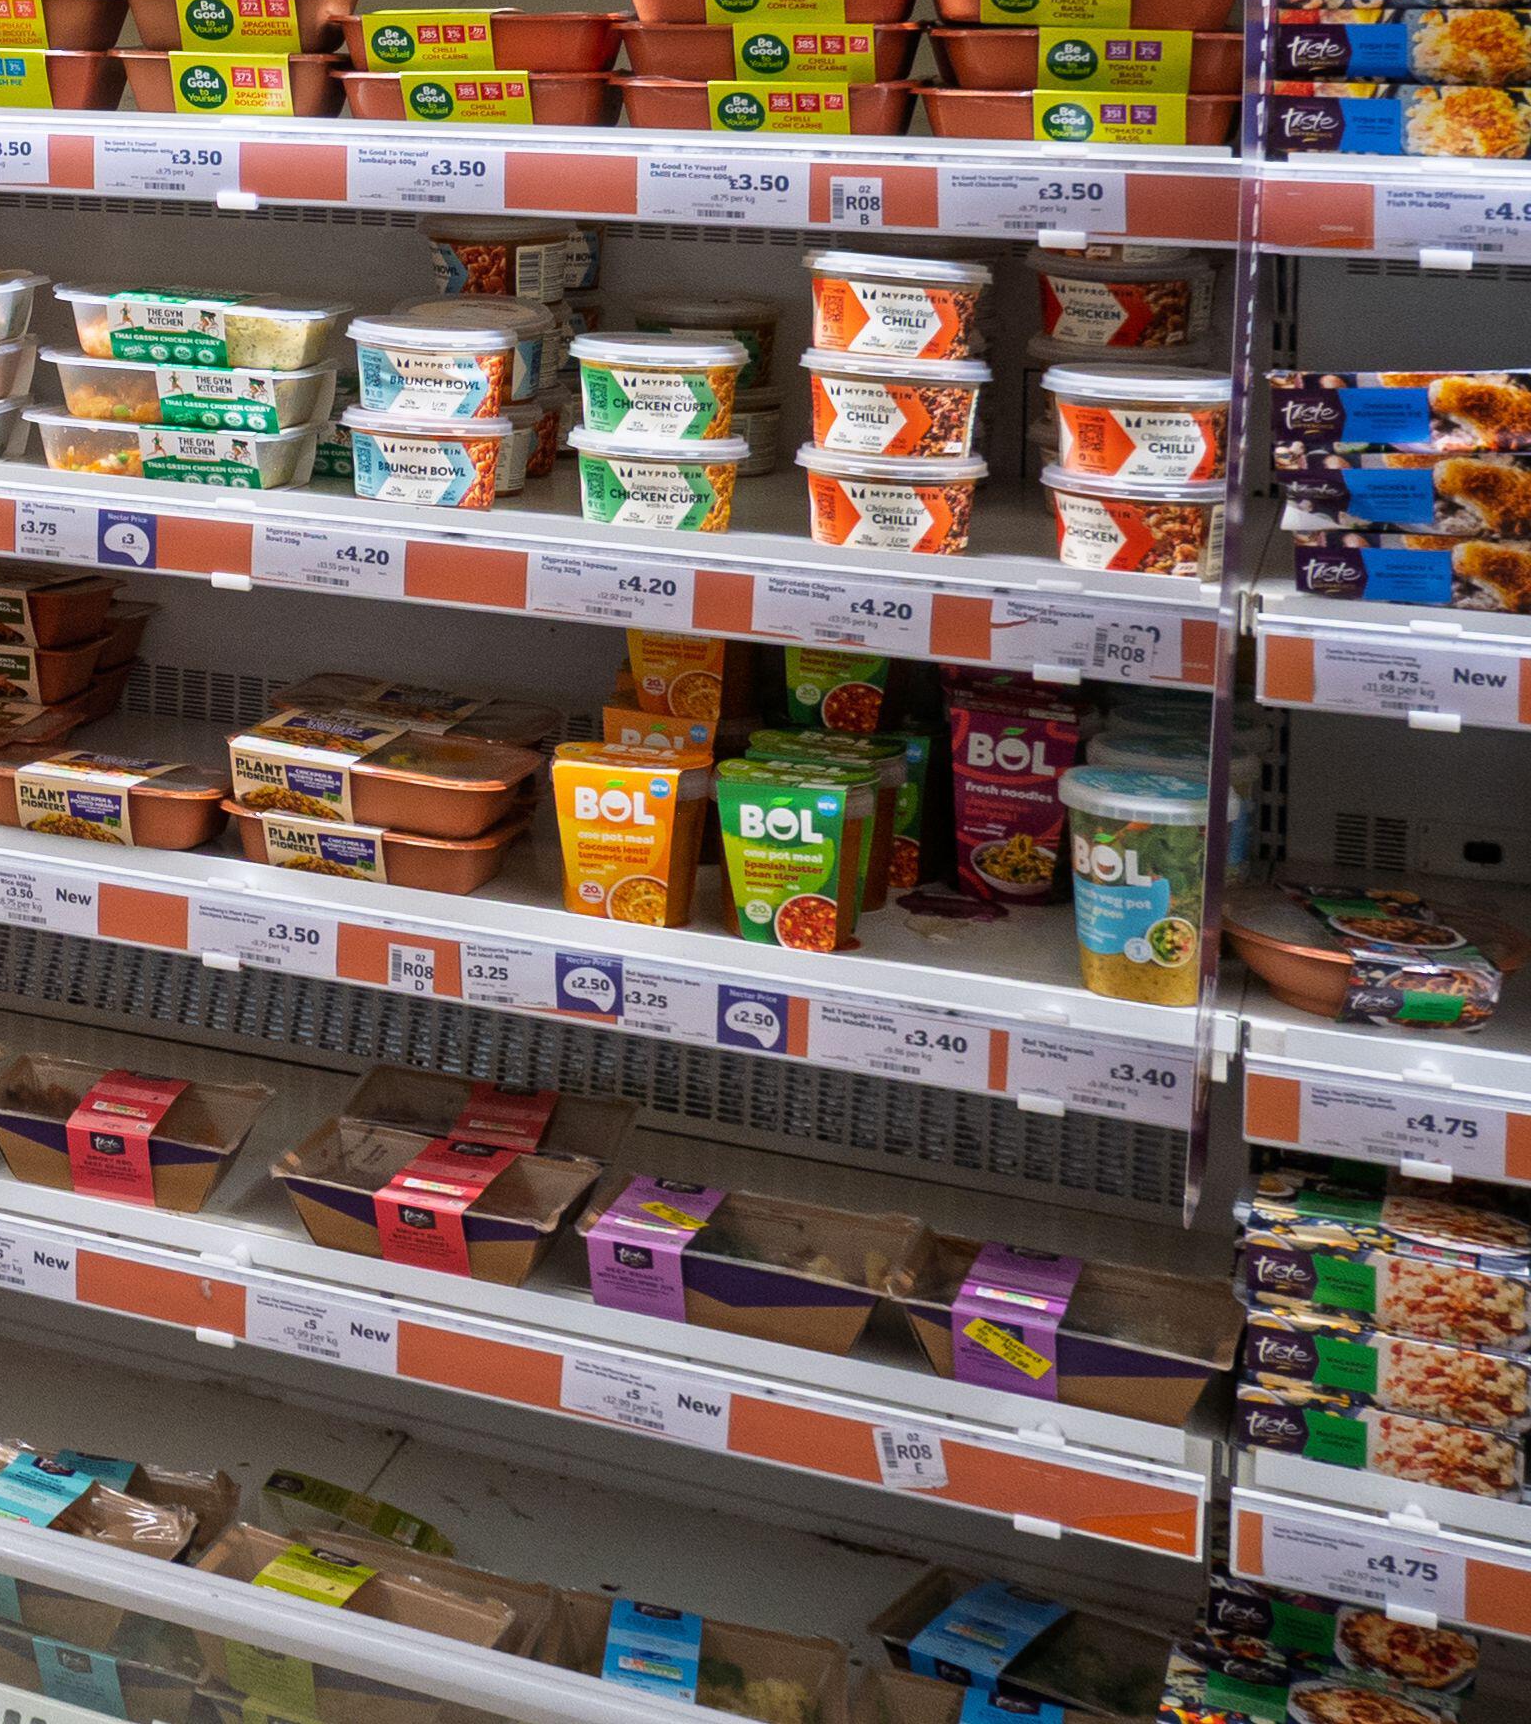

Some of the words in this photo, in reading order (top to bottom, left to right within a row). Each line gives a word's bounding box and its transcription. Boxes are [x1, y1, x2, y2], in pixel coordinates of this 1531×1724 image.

[201, 0, 215, 10] Be
[193, 10, 225, 20] Good
[206, 19, 215, 27] to
[243, 20, 289, 28] SPAGHETTI
[194, 25, 229, 35] Yourself
[241, 28, 293, 37] BOLOGNESE
[171, 150, 222, 166] £3.50
[431, 160, 486, 177] £3.50
[729, 173, 790, 193] £3.50
[1038, 182, 1104, 202] £3.50
[846, 195, 880, 212] R08
[860, 213, 870, 226] B
[881, 314, 927, 329] CHILLI
[414, 359, 474, 370] MYPROTEIN
[389, 375, 442, 388] BRUNCH
[446, 378, 481, 391] BOWL
[642, 379, 705, 389] MYPROTEIN
[613, 399, 670, 411] CHICKEN
[674, 401, 713, 413] CURRY
[20, 521, 57, 536] £3.75
[336, 546, 390, 566] £4.20
[619, 576, 677, 596] £4.20
[850, 599, 913, 620] £4.20
[1107, 645, 1145, 665] R08
[1378, 669, 1419, 685] £4.75
[1452, 666, 1508, 688] New
[967, 732, 1056, 776] BOL
[965, 781, 998, 796] fresh
[1001, 785, 1052, 804] noodles
[574, 786, 655, 826] BOL
[740, 804, 823, 844] BOL
[744, 850, 765, 860] one
[768, 851, 790, 862] pot
[792, 852, 823, 863] meal
[55, 887, 92, 907] New
[403, 962, 434, 980] R08
[467, 964, 509, 982] £3.25
[571, 976, 610, 993] £2.50
[905, 1028, 968, 1054] £3.40
[1109, 1064, 1177, 1090] £3.40
[1406, 1113, 1478, 1140] £4.75
[677, 1392, 722, 1417] New
[897, 1442, 932, 1460] R08
[1366, 1555, 1438, 1583] £4.75
